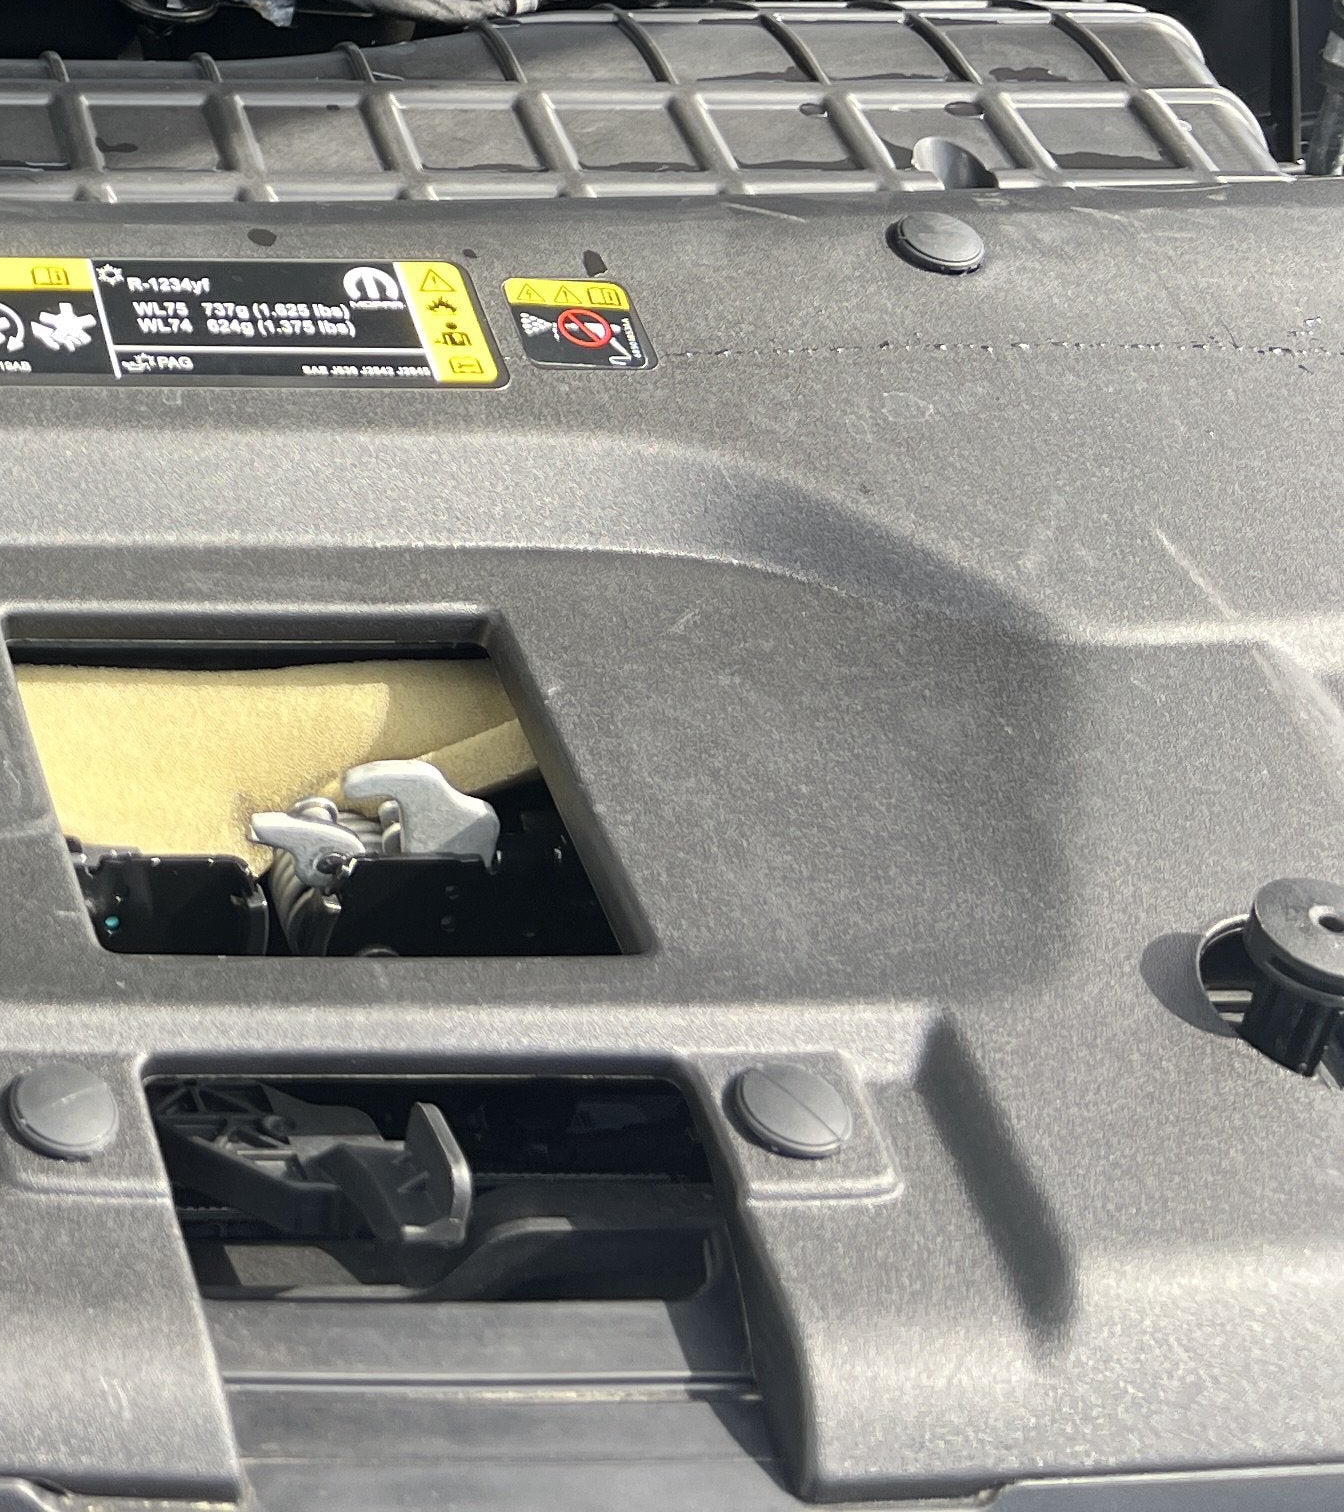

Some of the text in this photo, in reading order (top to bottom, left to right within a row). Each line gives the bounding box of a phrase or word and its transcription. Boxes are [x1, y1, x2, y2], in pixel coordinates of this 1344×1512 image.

[126, 276, 210, 295] R-1234yf
[132, 301, 189, 317] WL75
[201, 302, 250, 319] 737g
[312, 303, 351, 321] lbs)
[136, 317, 193, 334] WL74
[317, 320, 357, 338] lbs)
[156, 355, 194, 370] PAG
